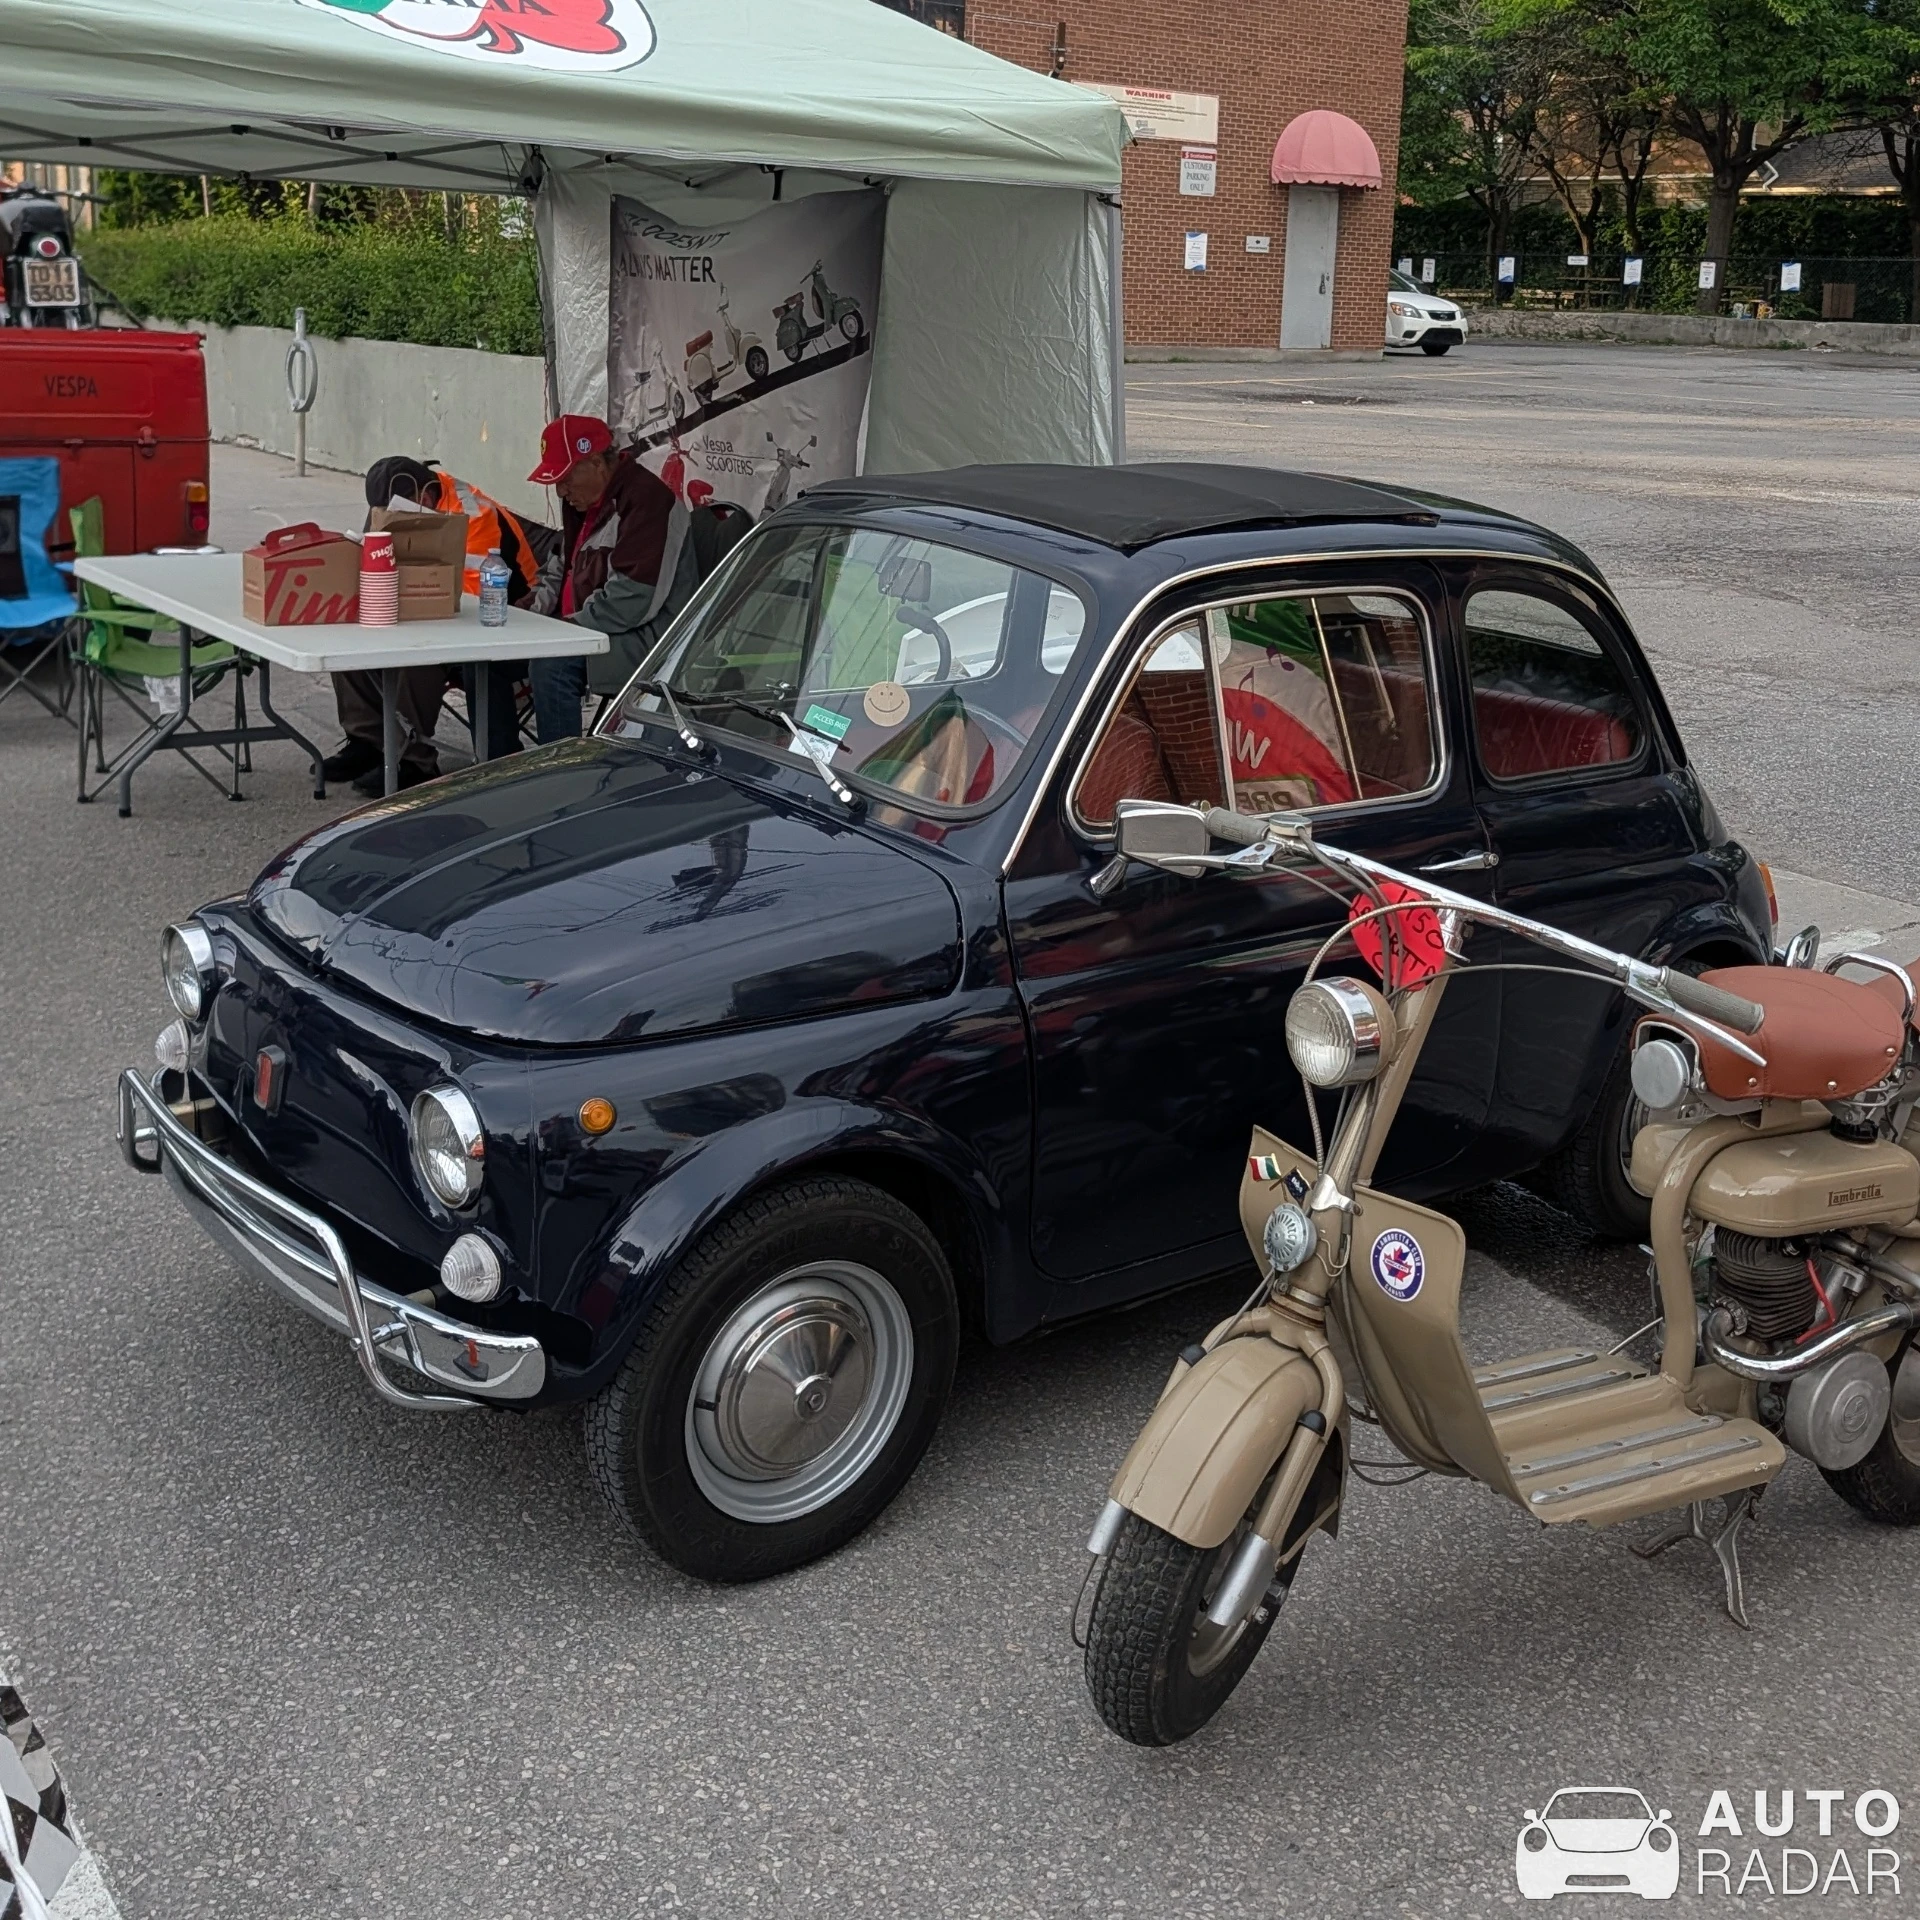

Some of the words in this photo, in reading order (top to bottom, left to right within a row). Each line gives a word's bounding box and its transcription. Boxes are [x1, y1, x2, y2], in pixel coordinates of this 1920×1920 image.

[1125, 89, 1172, 100] WARNING
[1184, 161, 1212, 171] CUSTOMER
[1186, 172, 1210, 182] PARKING
[1190, 183, 1205, 192] ONLY
[642, 224, 731, 251] DOESN'T
[655, 255, 716, 283] MATTER
[44, 375, 98, 397] VESPA
[702, 435, 734, 454] Vespa
[705, 455, 754, 476] SCOOTERS
[813, 713, 835, 726] ACCESS
[1828, 1184, 1884, 1207] Lambretta
[1376, 1233, 1410, 1250] LAMBRETTA
[1410, 1247, 1422, 1267] CLUB
[1384, 1283, 1406, 1298] CANADA
